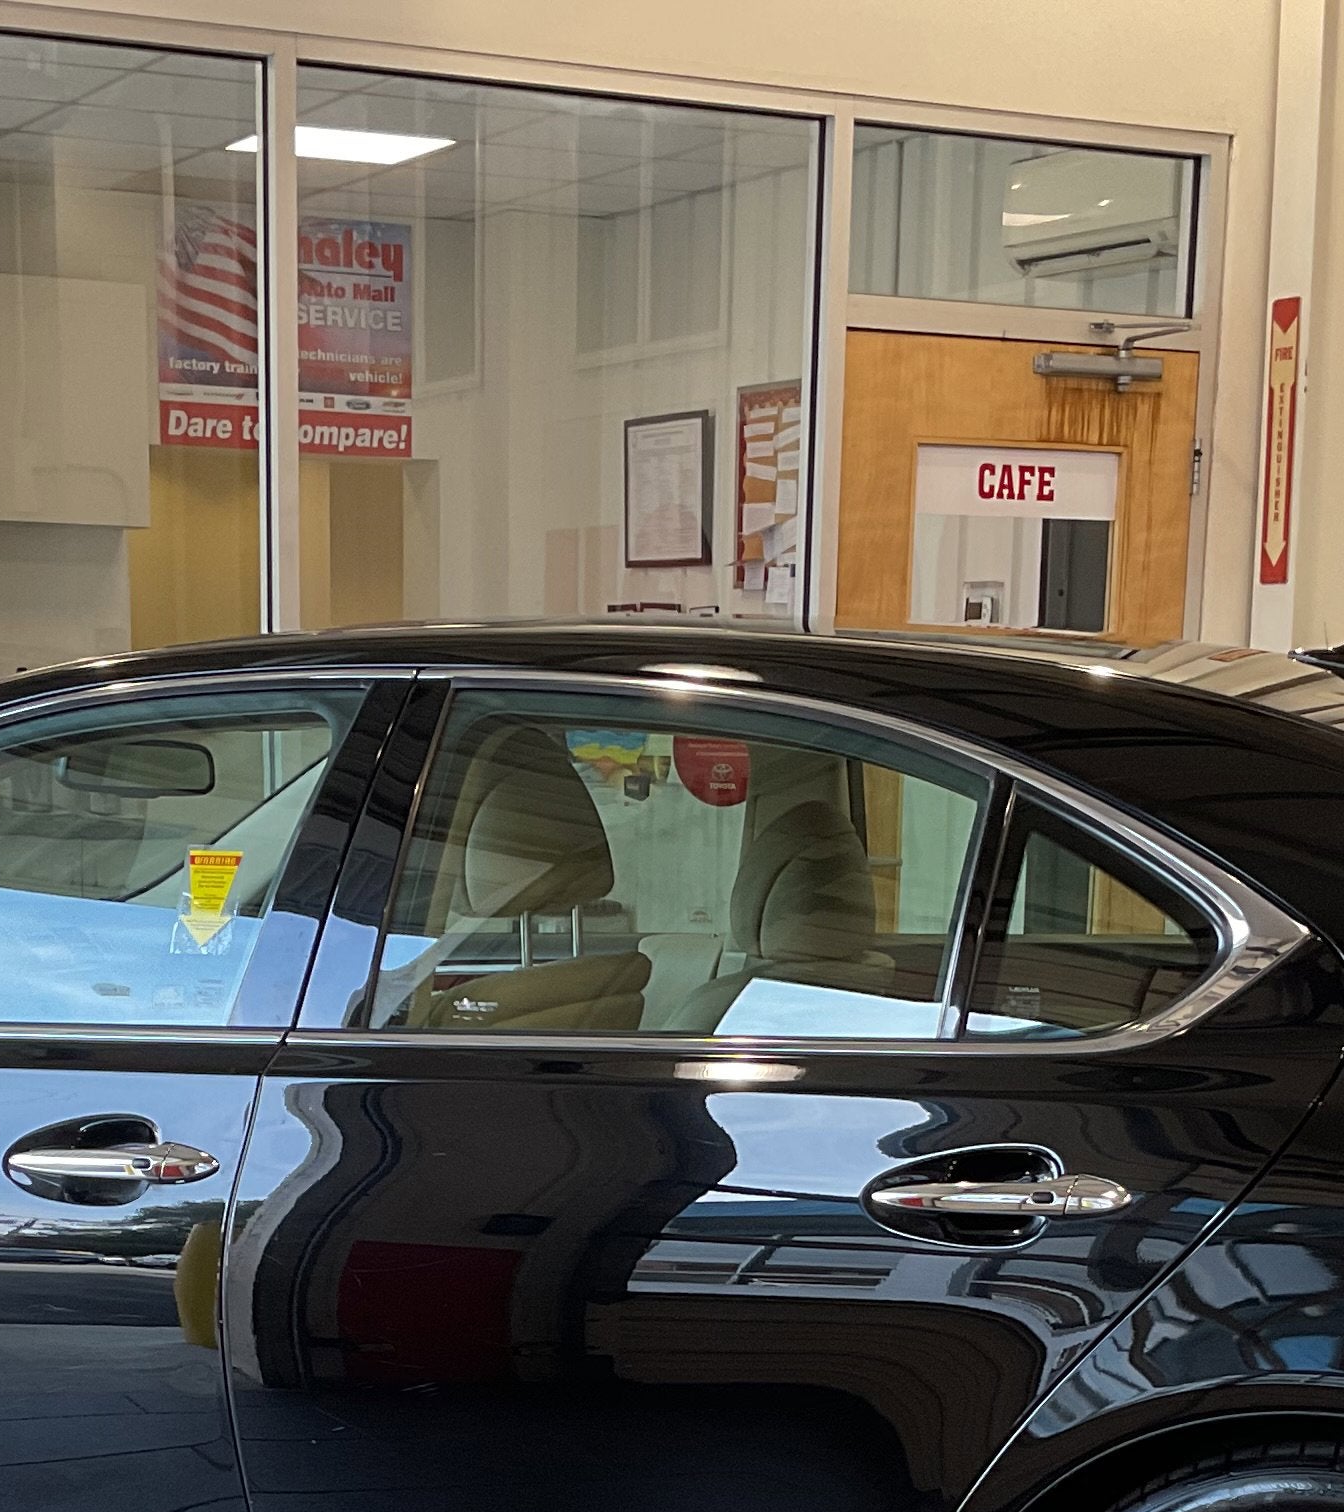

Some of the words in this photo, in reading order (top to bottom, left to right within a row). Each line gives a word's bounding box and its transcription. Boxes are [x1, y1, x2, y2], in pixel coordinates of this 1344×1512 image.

[353, 283, 396, 302] Mall
[297, 303, 402, 331] SERVICE
[168, 357, 221, 374] factory
[297, 349, 375, 365] echnicians
[380, 355, 402, 365] are
[1274, 346, 1294, 362] FIRE
[349, 370, 403, 384] vehicle!
[168, 409, 233, 439] Dare
[298, 423, 408, 452] ompare!
[1273, 382, 1286, 522] EXTINGUISHER
[978, 463, 1056, 501] CAFE
